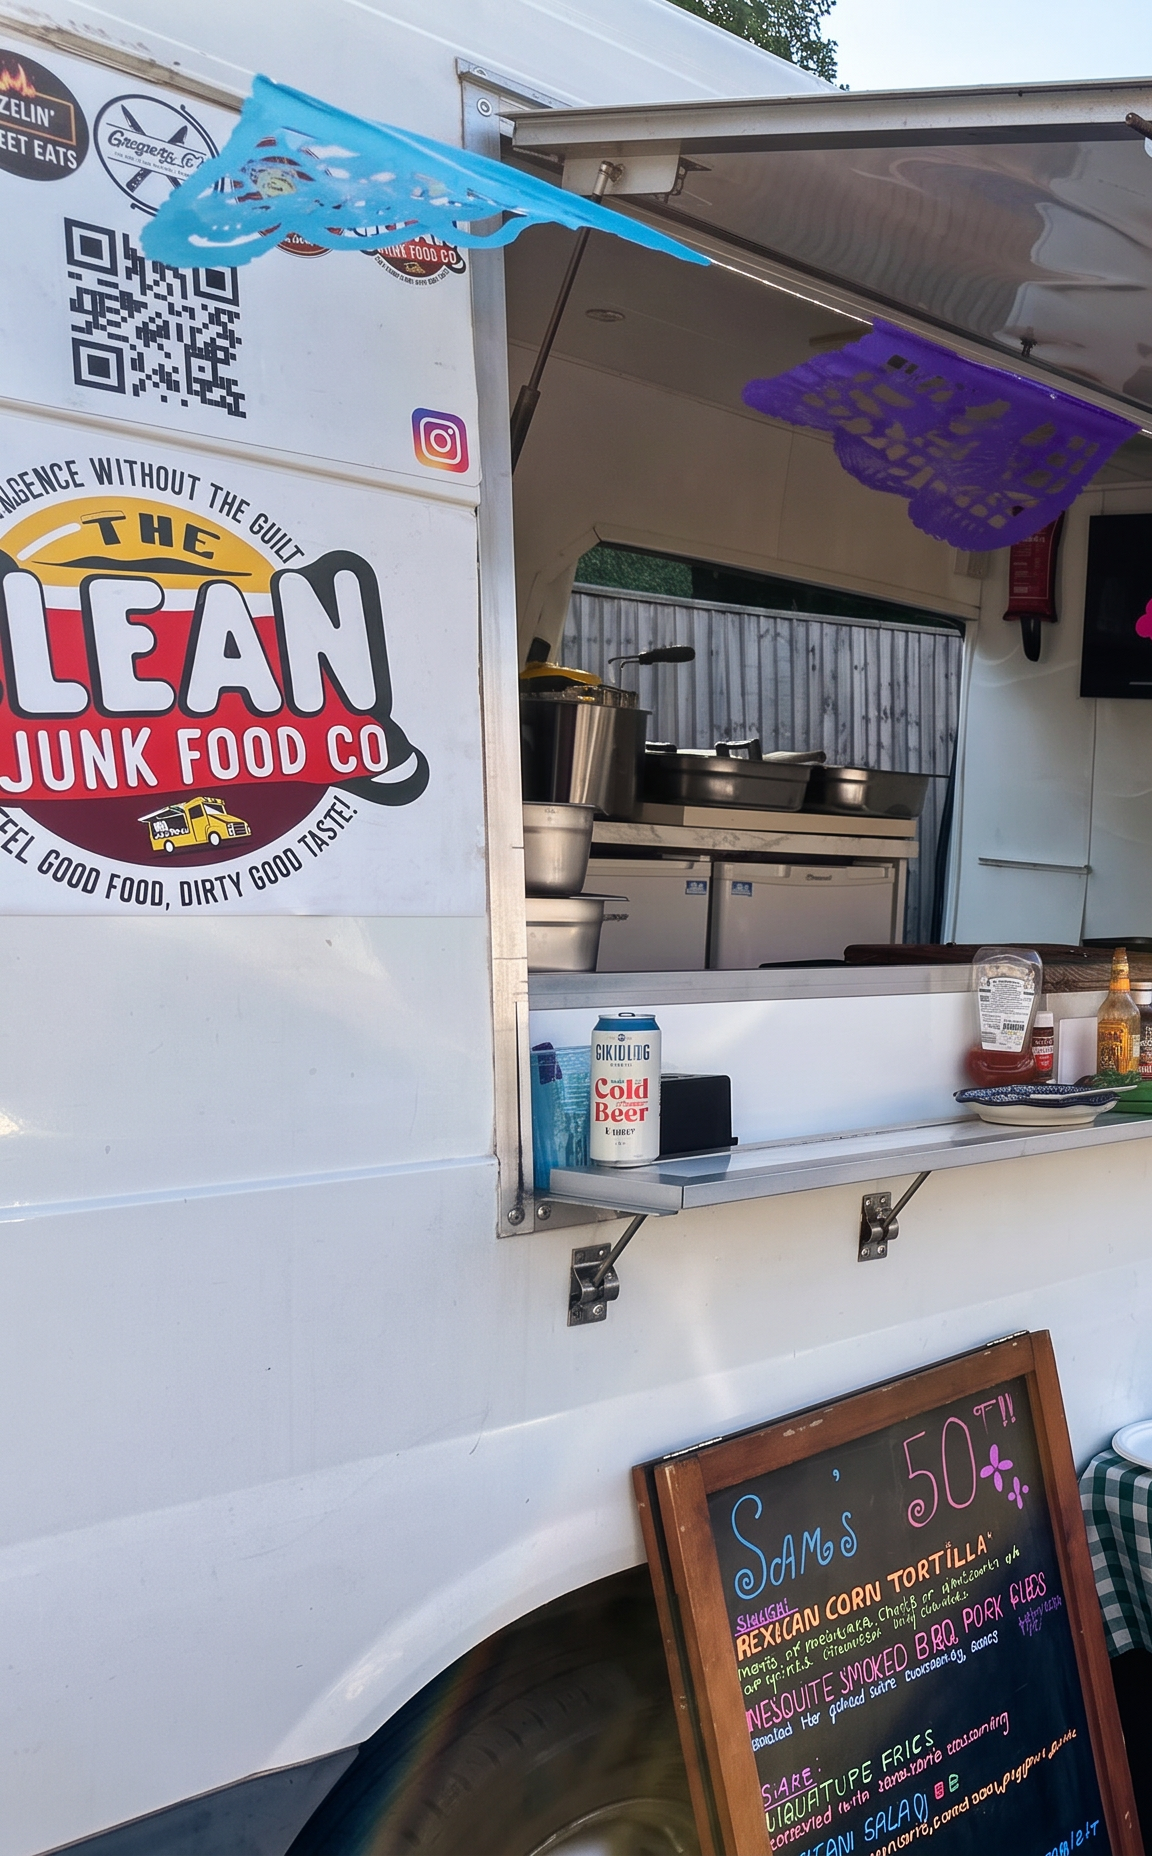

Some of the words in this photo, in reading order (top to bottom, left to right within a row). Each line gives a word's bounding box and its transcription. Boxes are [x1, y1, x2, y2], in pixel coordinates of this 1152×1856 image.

[34, 139, 78, 169] EATS
[409, 244, 438, 262] FOOD
[440, 249, 457, 264] CO
[89, 457, 201, 501] WITHOUT
[208, 482, 251, 524] THE
[249, 512, 305, 564] GUILT
[80, 510, 221, 560] THE
[1, 726, 158, 793] JUNK
[177, 726, 306, 786] FOOD
[326, 723, 390, 774] CO
[37, 848, 101, 895] GOOD
[105, 872, 171, 911] FOOD,
[179, 871, 244, 908] DIRTY
[248, 847, 303, 891] GOOD
[297, 795, 359, 859] TASTE!
[595, 1077, 649, 1100] Cold
[595, 1101, 649, 1123] Beer
[825, 1580, 882, 1620] CORN
